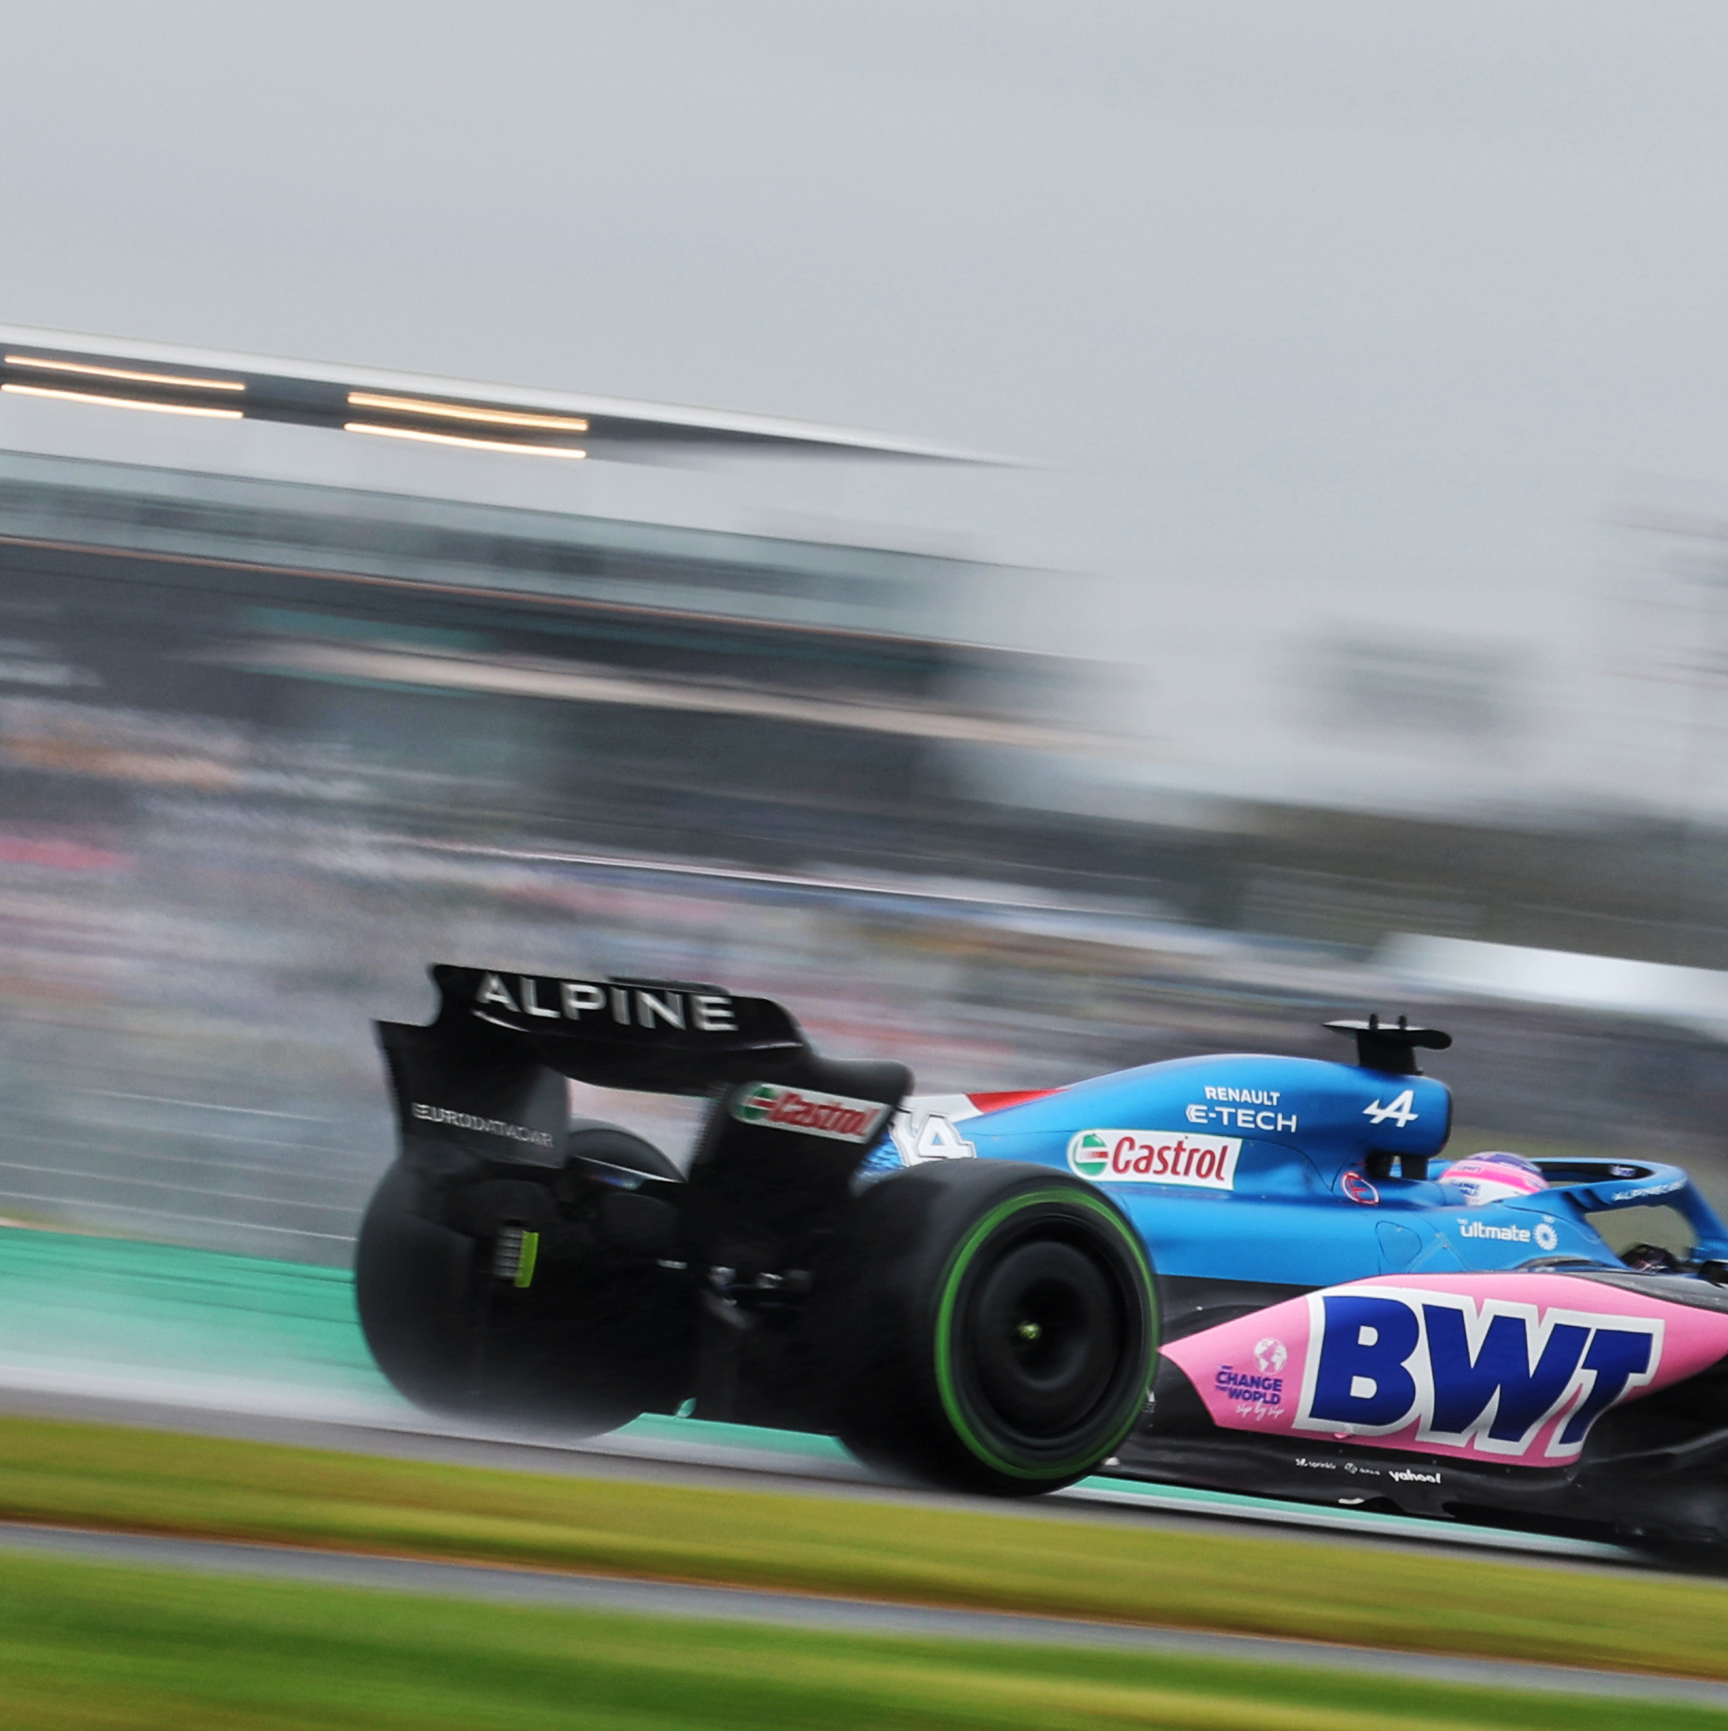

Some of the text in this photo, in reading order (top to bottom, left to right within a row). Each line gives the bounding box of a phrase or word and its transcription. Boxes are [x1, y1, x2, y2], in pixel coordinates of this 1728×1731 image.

[475, 972, 739, 1031] ALPINE
[1204, 1085, 1280, 1106] RENAULT
[766, 1092, 880, 1137] Castrol
[1186, 1103, 1298, 1133] E-TECH
[1112, 1136, 1229, 1181] Castrol
[1216, 1371, 1283, 1392] CHANGE
[1300, 1290, 1660, 1453] BWT
[1228, 1388, 1281, 1405] WORLD
